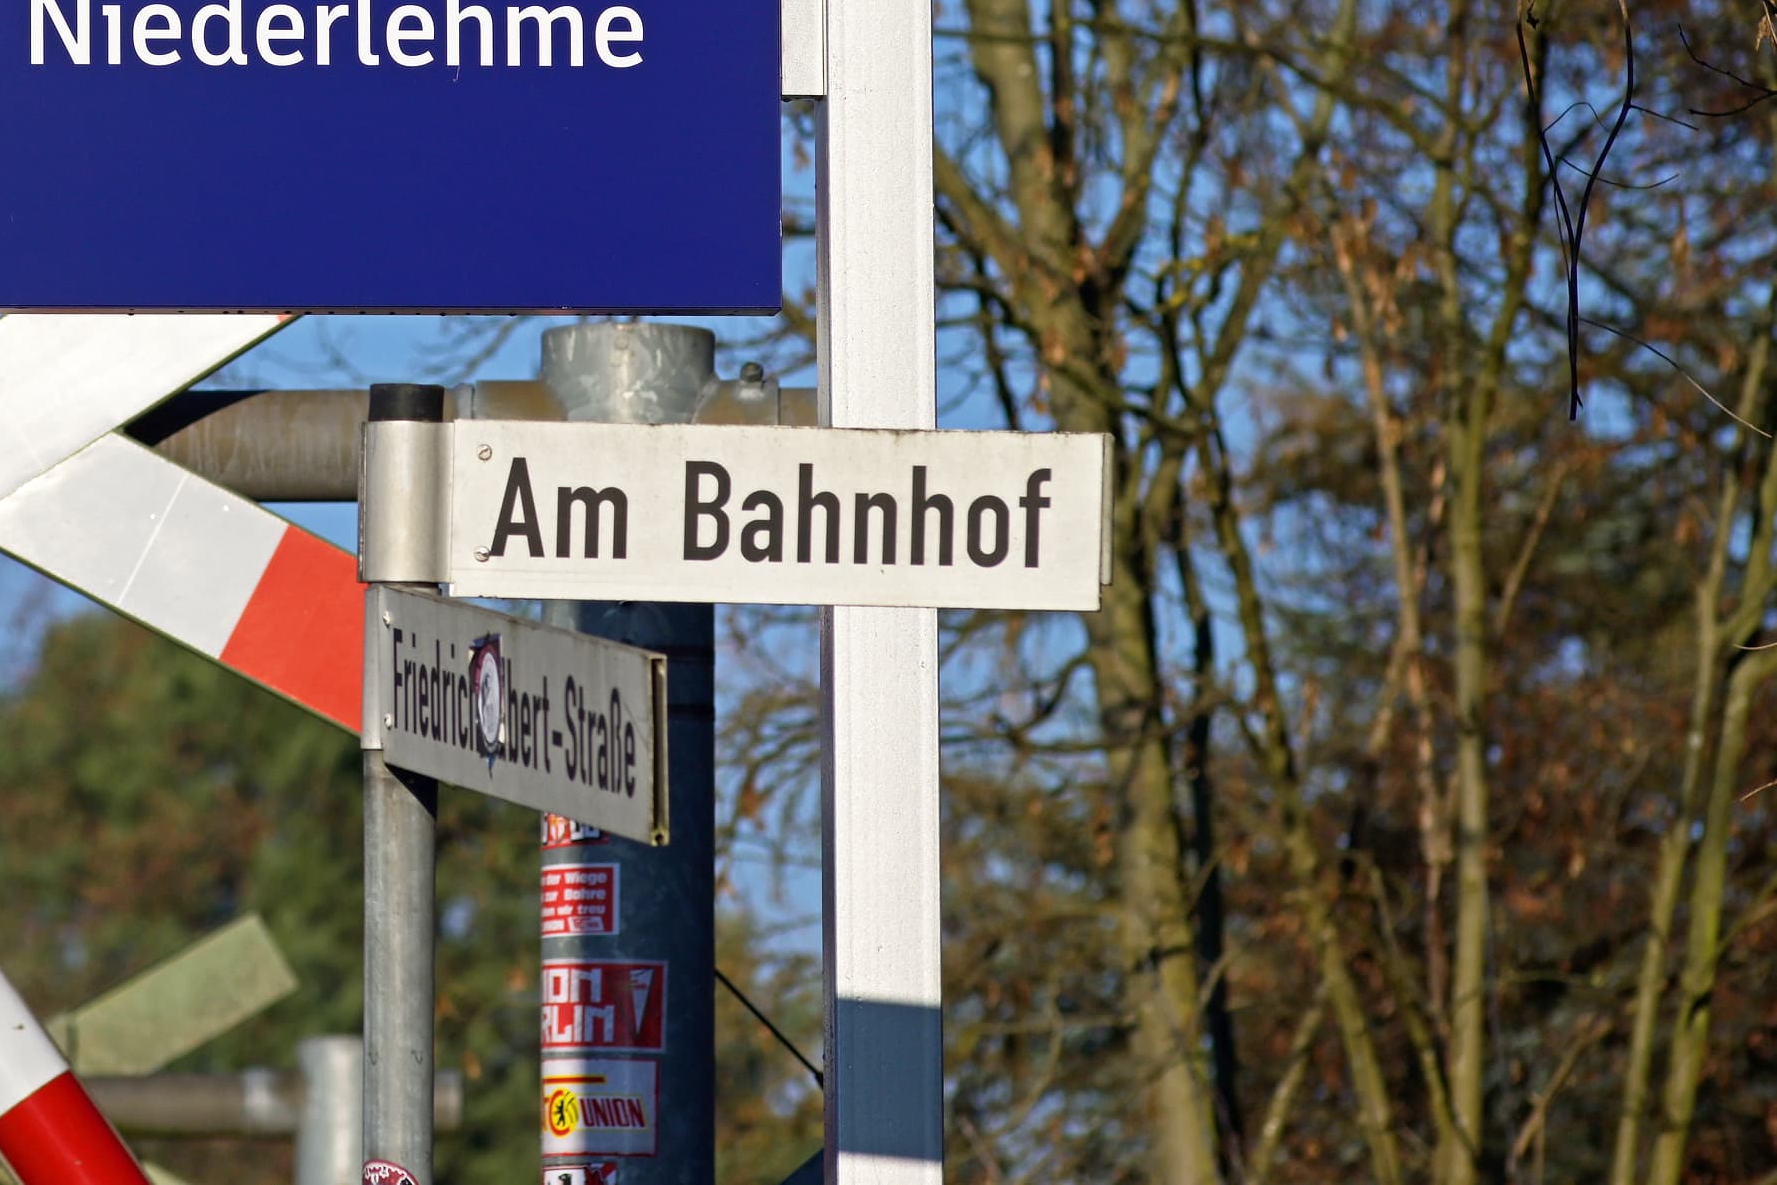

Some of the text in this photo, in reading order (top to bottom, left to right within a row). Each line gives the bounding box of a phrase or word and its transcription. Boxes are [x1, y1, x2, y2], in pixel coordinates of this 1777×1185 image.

[490, 457, 1052, 569] Am Bahnhof
[579, 1097, 646, 1128] UNION
